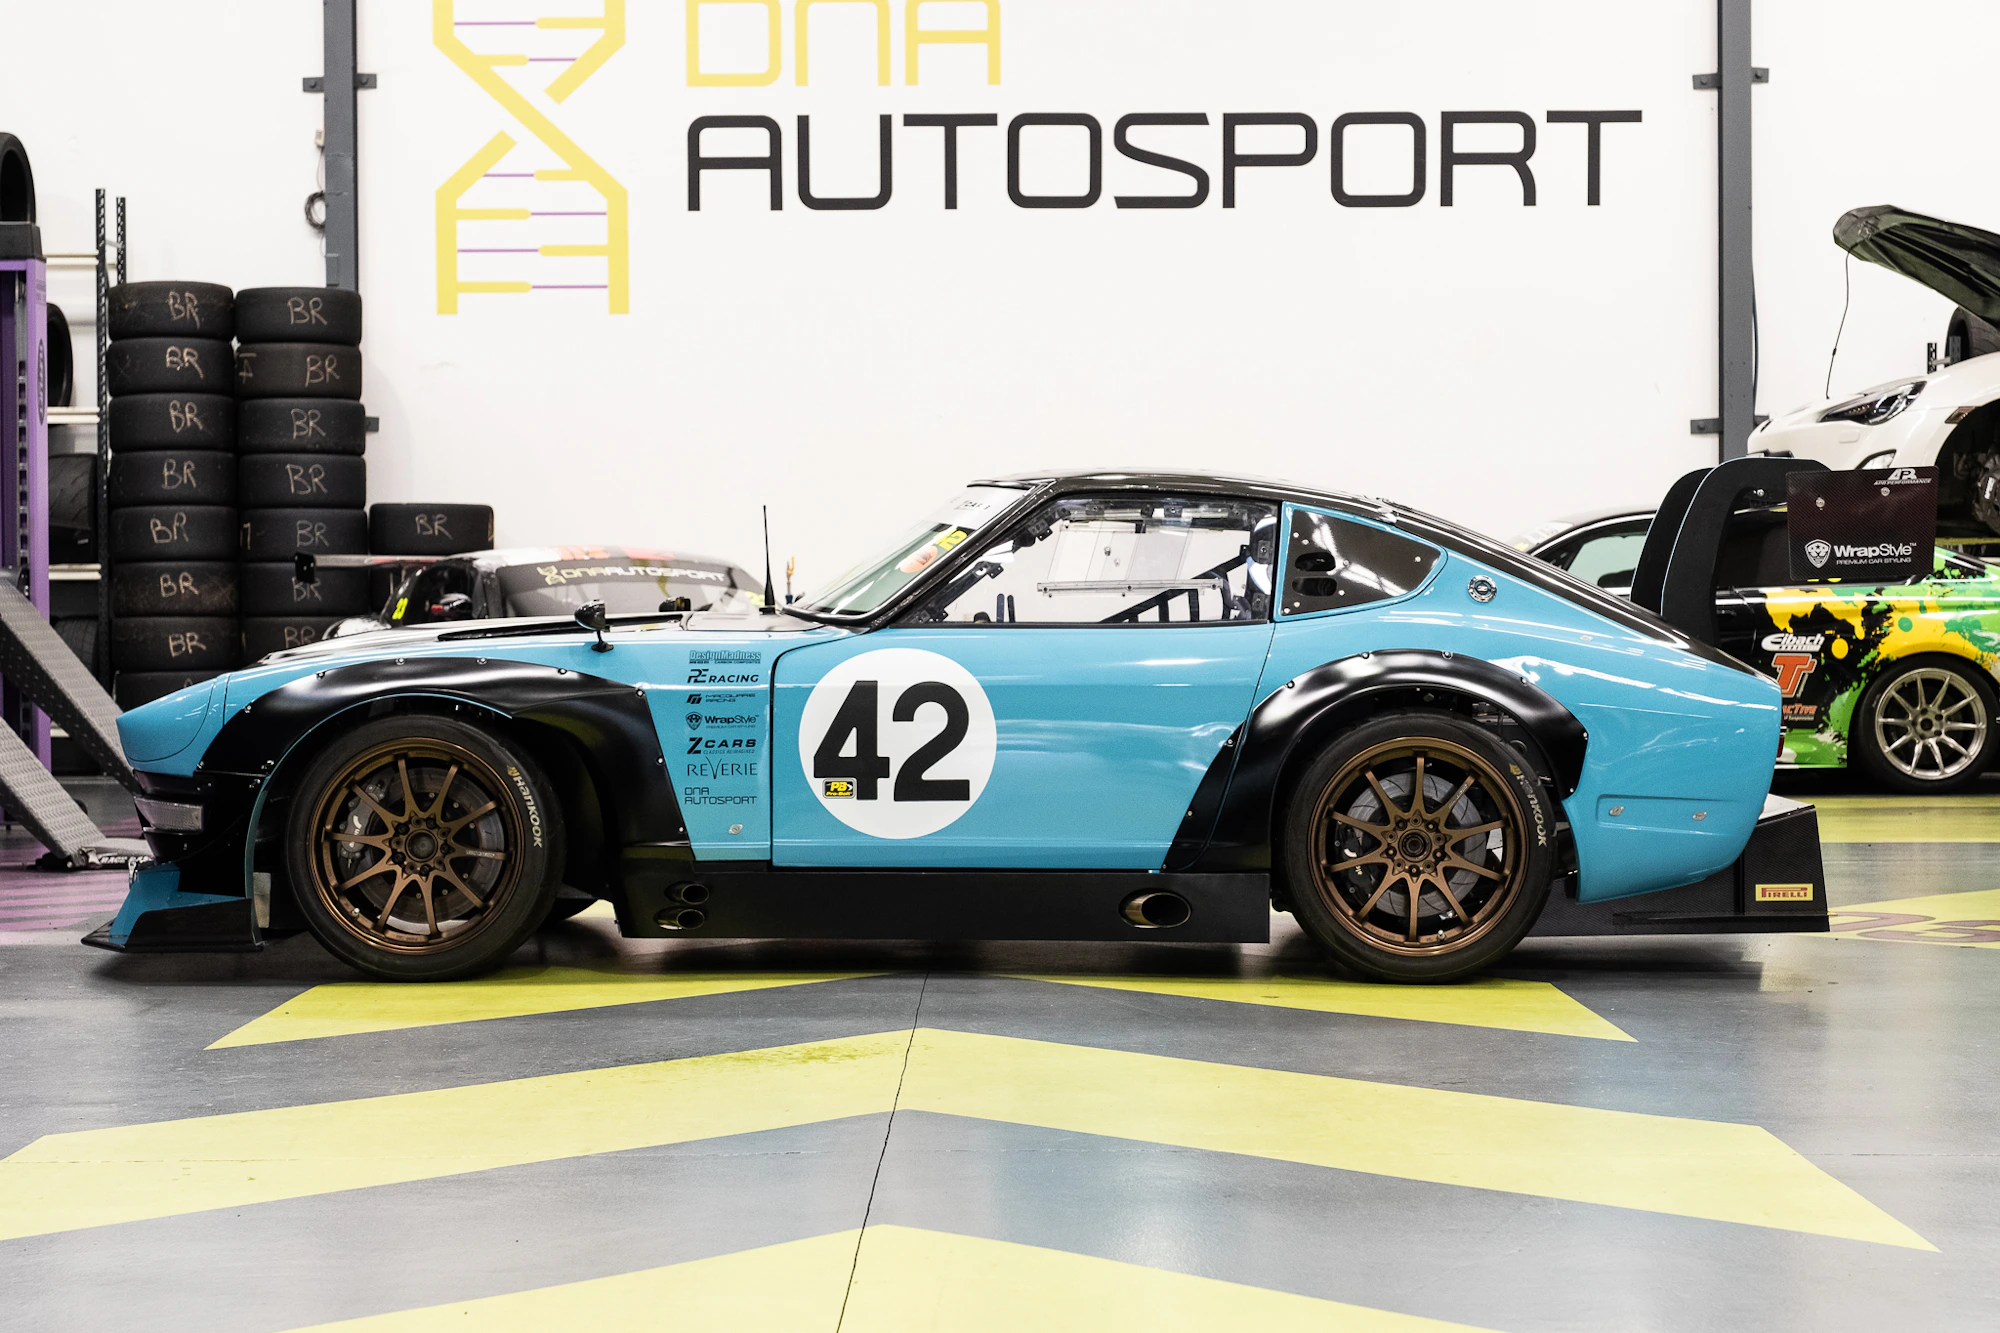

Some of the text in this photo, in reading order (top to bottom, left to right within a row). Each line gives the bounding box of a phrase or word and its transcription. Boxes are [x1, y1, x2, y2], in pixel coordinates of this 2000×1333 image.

[686, 0, 1001, 87] DNA
[687, 110, 1642, 211] AUTOSPORT
[167, 290, 200, 331] BR
[287, 296, 328, 325] BR
[305, 354, 341, 388] BR
[169, 400, 204, 433] BR
[290, 408, 326, 440] BR
[162, 458, 197, 490] BR
[285, 463, 328, 494] BR
[150, 511, 190, 544] BR
[296, 519, 330, 548] BR
[415, 513, 454, 540] BR
[1836, 558, 1868, 566] PREMIUM
[160, 571, 199, 598] BR
[168, 631, 207, 658] BR
[689, 650, 762, 661] DesignMadness
[1761, 632, 1825, 652] Eibach
[708, 674, 760, 683] RACING
[686, 737, 757, 754] Z CARS
[813, 680, 971, 802] 42
[687, 756, 758, 780] REVERIE
[684, 786, 710, 796] DNA
[684, 795, 758, 805] AUTOSPORT
[830, 781, 848, 792] PB
[1761, 887, 1808, 898] PIRELLI
